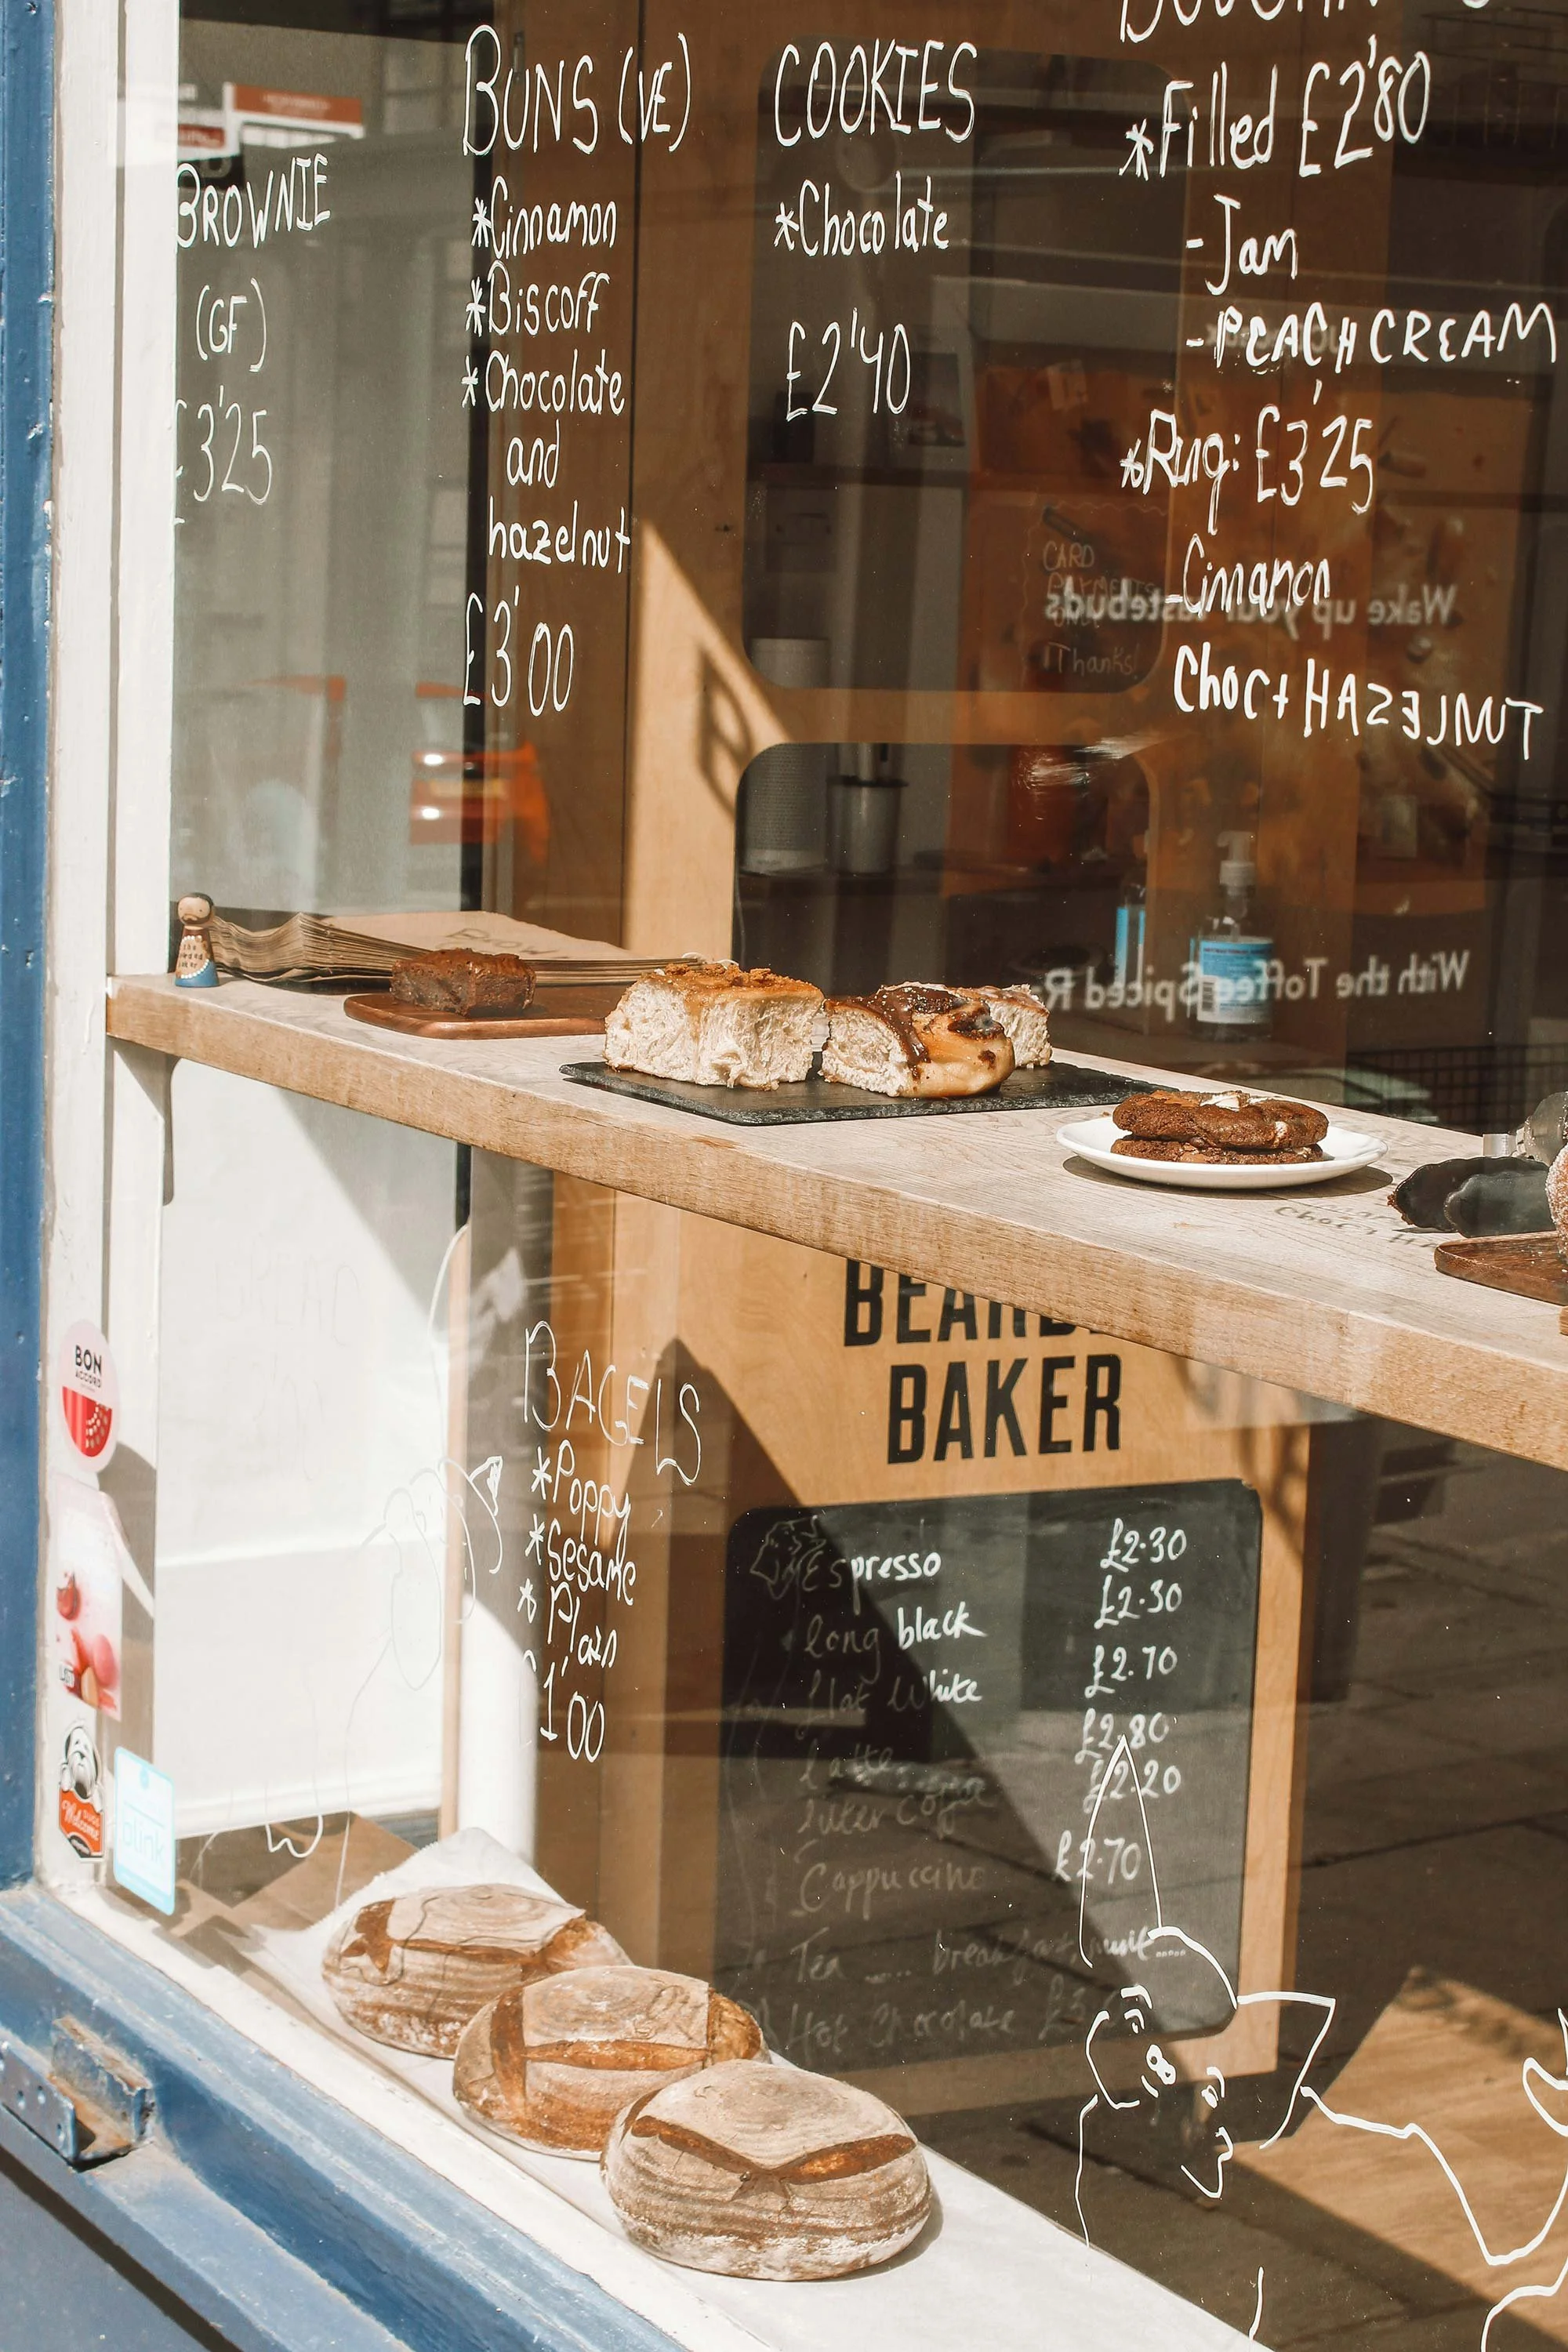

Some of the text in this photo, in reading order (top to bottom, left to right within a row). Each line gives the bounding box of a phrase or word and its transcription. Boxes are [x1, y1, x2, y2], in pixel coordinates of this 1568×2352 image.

[463, 24, 691, 155] BUNS (VE)
[775, 38, 978, 147] COOKIES
[1159, 60, 1278, 179] Filled
[175, 152, 330, 249] BROWNIE
[491, 175, 617, 260] Cinnamon
[798, 170, 949, 256] Chocolate
[196, 276, 267, 372] (GF)
[488, 260, 610, 336] Biscoff
[1370, 302, 1558, 364] CREAM
[485, 348, 625, 416] Chocolate
[506, 419, 562, 488] and
[488, 495, 630, 573] hazelnut
[1043, 540, 1095, 571] CARD
[75, 1345, 103, 1377] BON
[524, 1320, 702, 1486] BAGELS
[887, 1353, 1123, 1465] BAKER
[554, 1439, 632, 1566] Poppy
[547, 1518, 637, 1606] Sesame
[1100, 1518, 1187, 1573] £2.30
[547, 1581, 618, 1668] Plain
[898, 1601, 988, 1650] black
[1094, 1575, 1183, 1630] £2.30
[1084, 1645, 1178, 1698] £2.70
